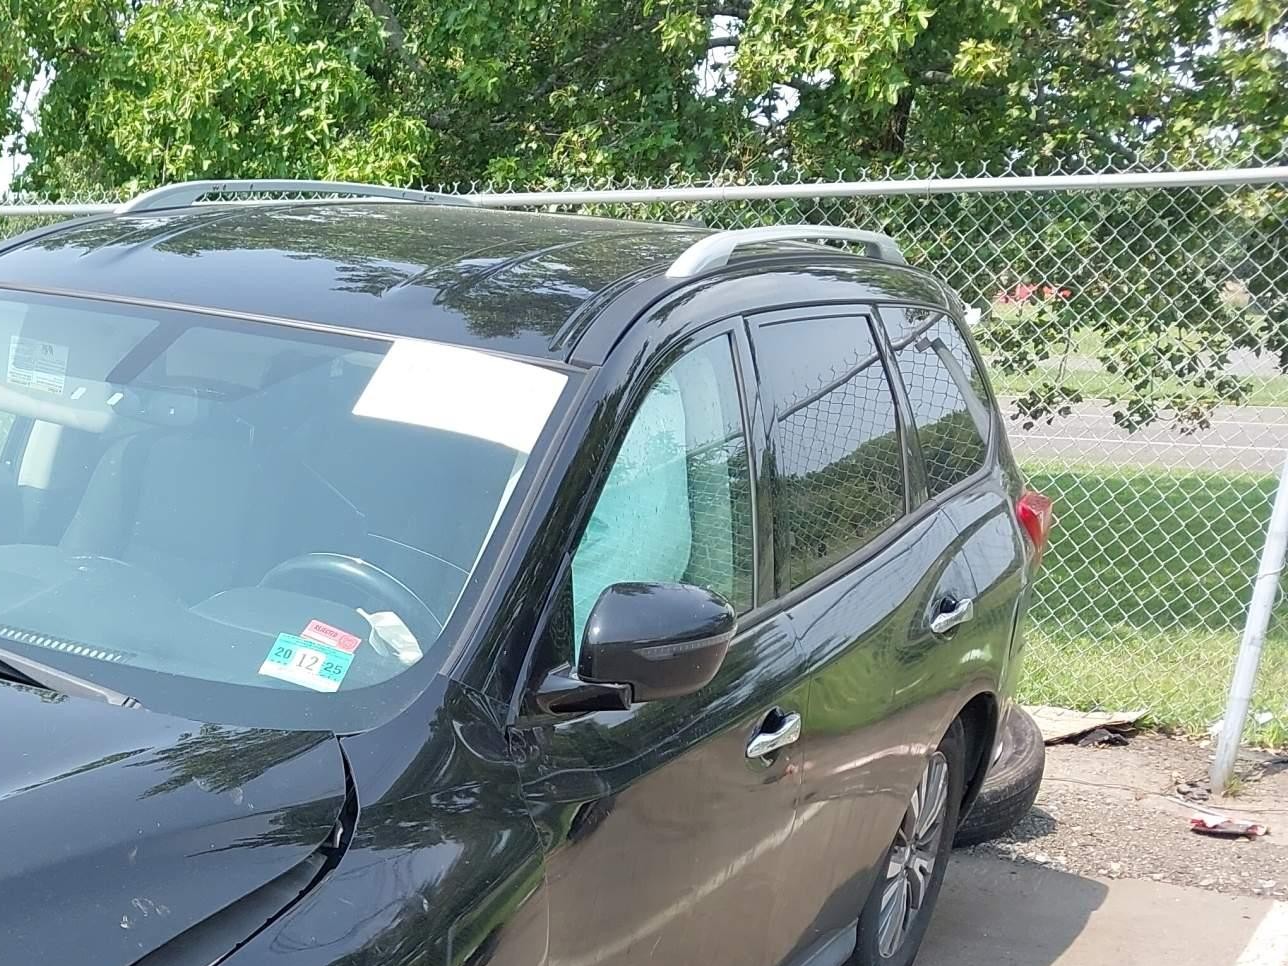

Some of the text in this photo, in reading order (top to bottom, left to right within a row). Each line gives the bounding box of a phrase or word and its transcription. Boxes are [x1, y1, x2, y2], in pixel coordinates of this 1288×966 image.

[274, 647, 293, 660] 20
[295, 653, 319, 671] 12
[324, 662, 343, 675] 25
